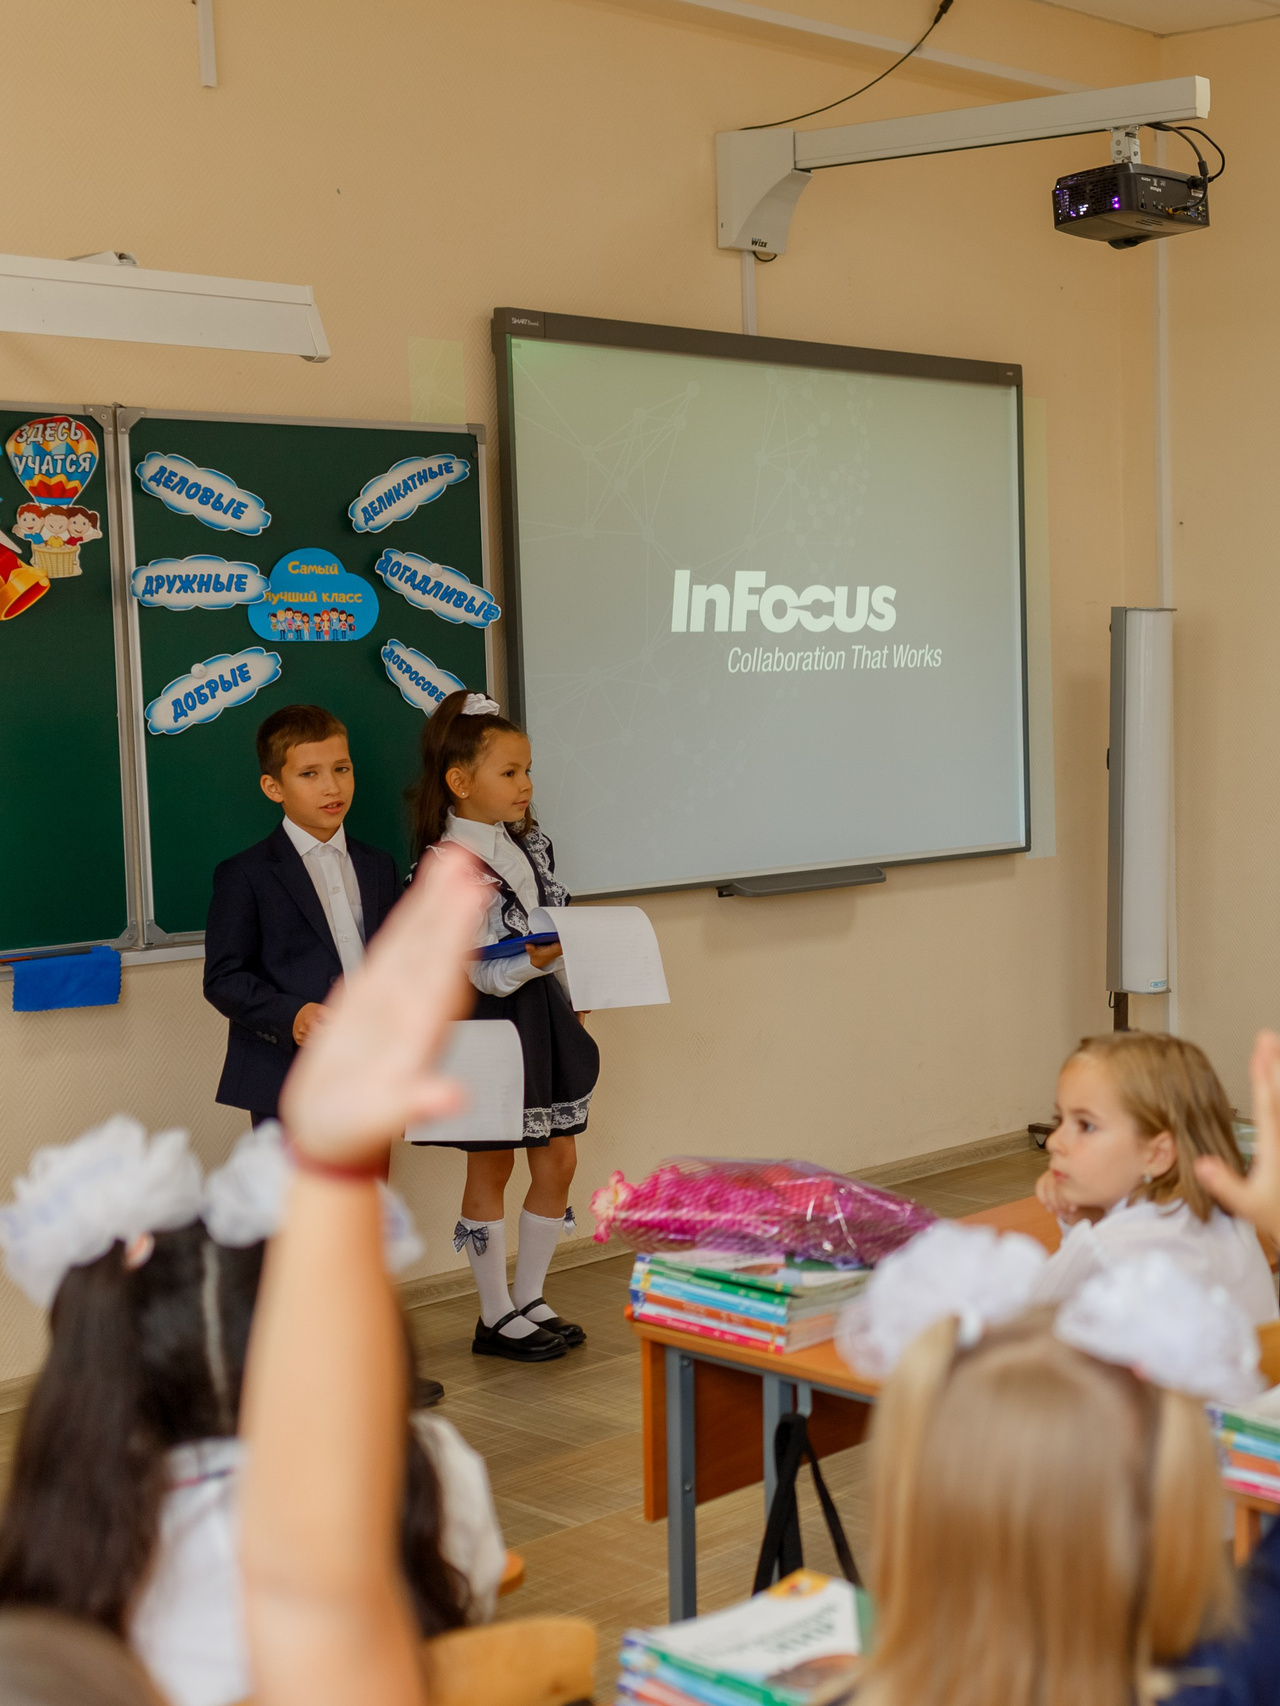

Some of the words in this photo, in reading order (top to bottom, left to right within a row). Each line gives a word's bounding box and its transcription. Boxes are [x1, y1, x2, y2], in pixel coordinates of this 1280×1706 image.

[16, 421, 82, 445] ЗДЕСЬ
[14, 453, 92, 475] УЧАТСЯ
[148, 465, 249, 521] ДЕЛОВЫЕ
[360, 461, 455, 526] ДЕЛИКАТНЫЕ
[141, 573, 248, 598] ДРУЖНЫЕ
[288, 561, 339, 575] Самый
[375, 553, 500, 623] ДОГАДЛИВЫЕ
[264, 590, 319, 605] лучший
[321, 592, 363, 603] класс
[670, 569, 897, 634] InFocus
[384, 645, 448, 704] ДОБРОСОВЕ
[727, 645, 846, 674] Collaboration
[851, 644, 889, 670] That
[892, 643, 943, 669] Works
[171, 662, 252, 723] ДОБРЫЕ
